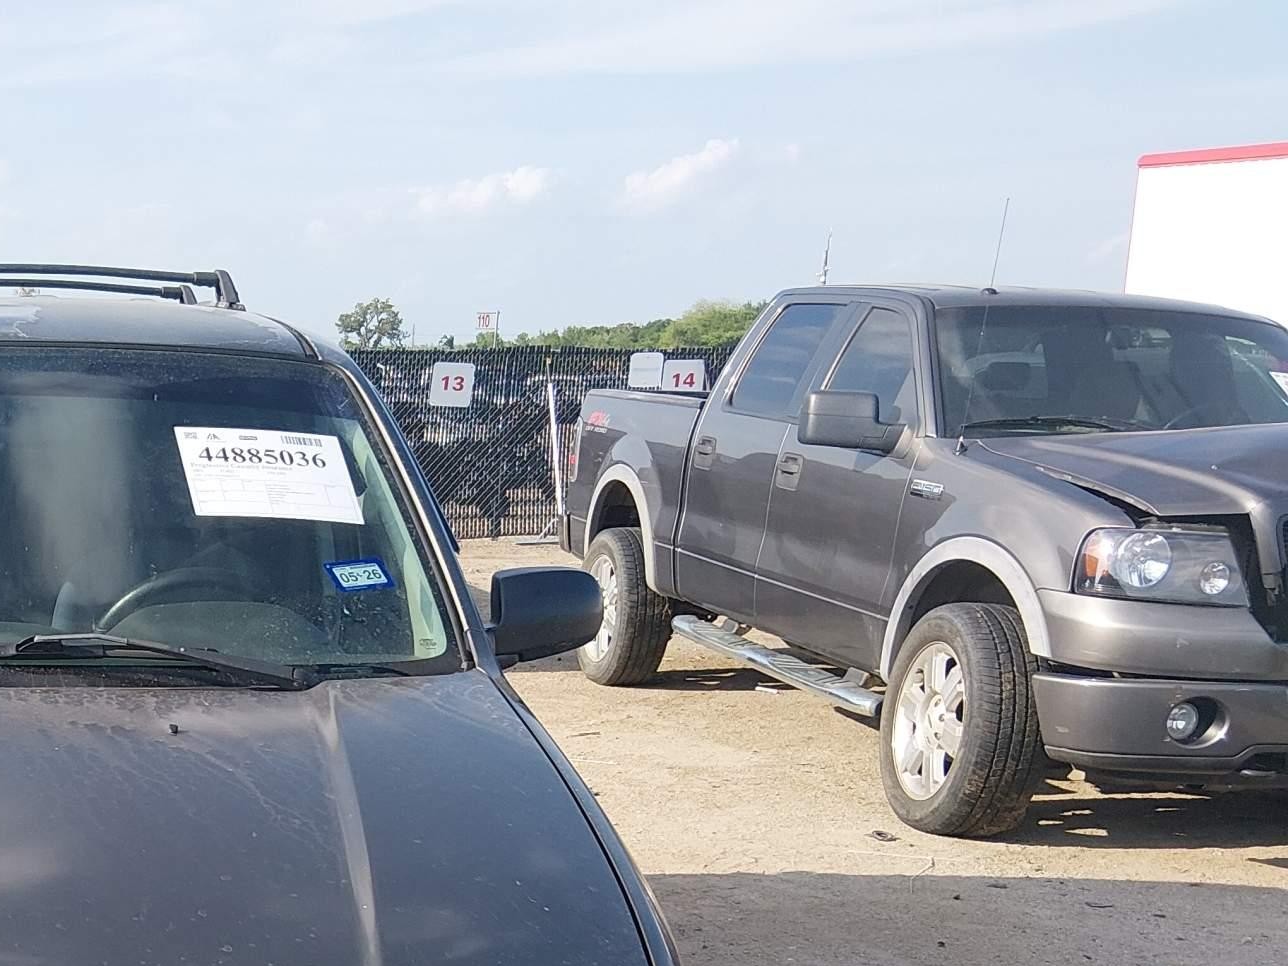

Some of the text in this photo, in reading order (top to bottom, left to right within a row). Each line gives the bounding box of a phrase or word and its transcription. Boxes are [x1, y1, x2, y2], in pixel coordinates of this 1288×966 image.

[441, 376, 465, 392] 13
[672, 373, 696, 388] 14
[198, 446, 327, 469] 44885036
